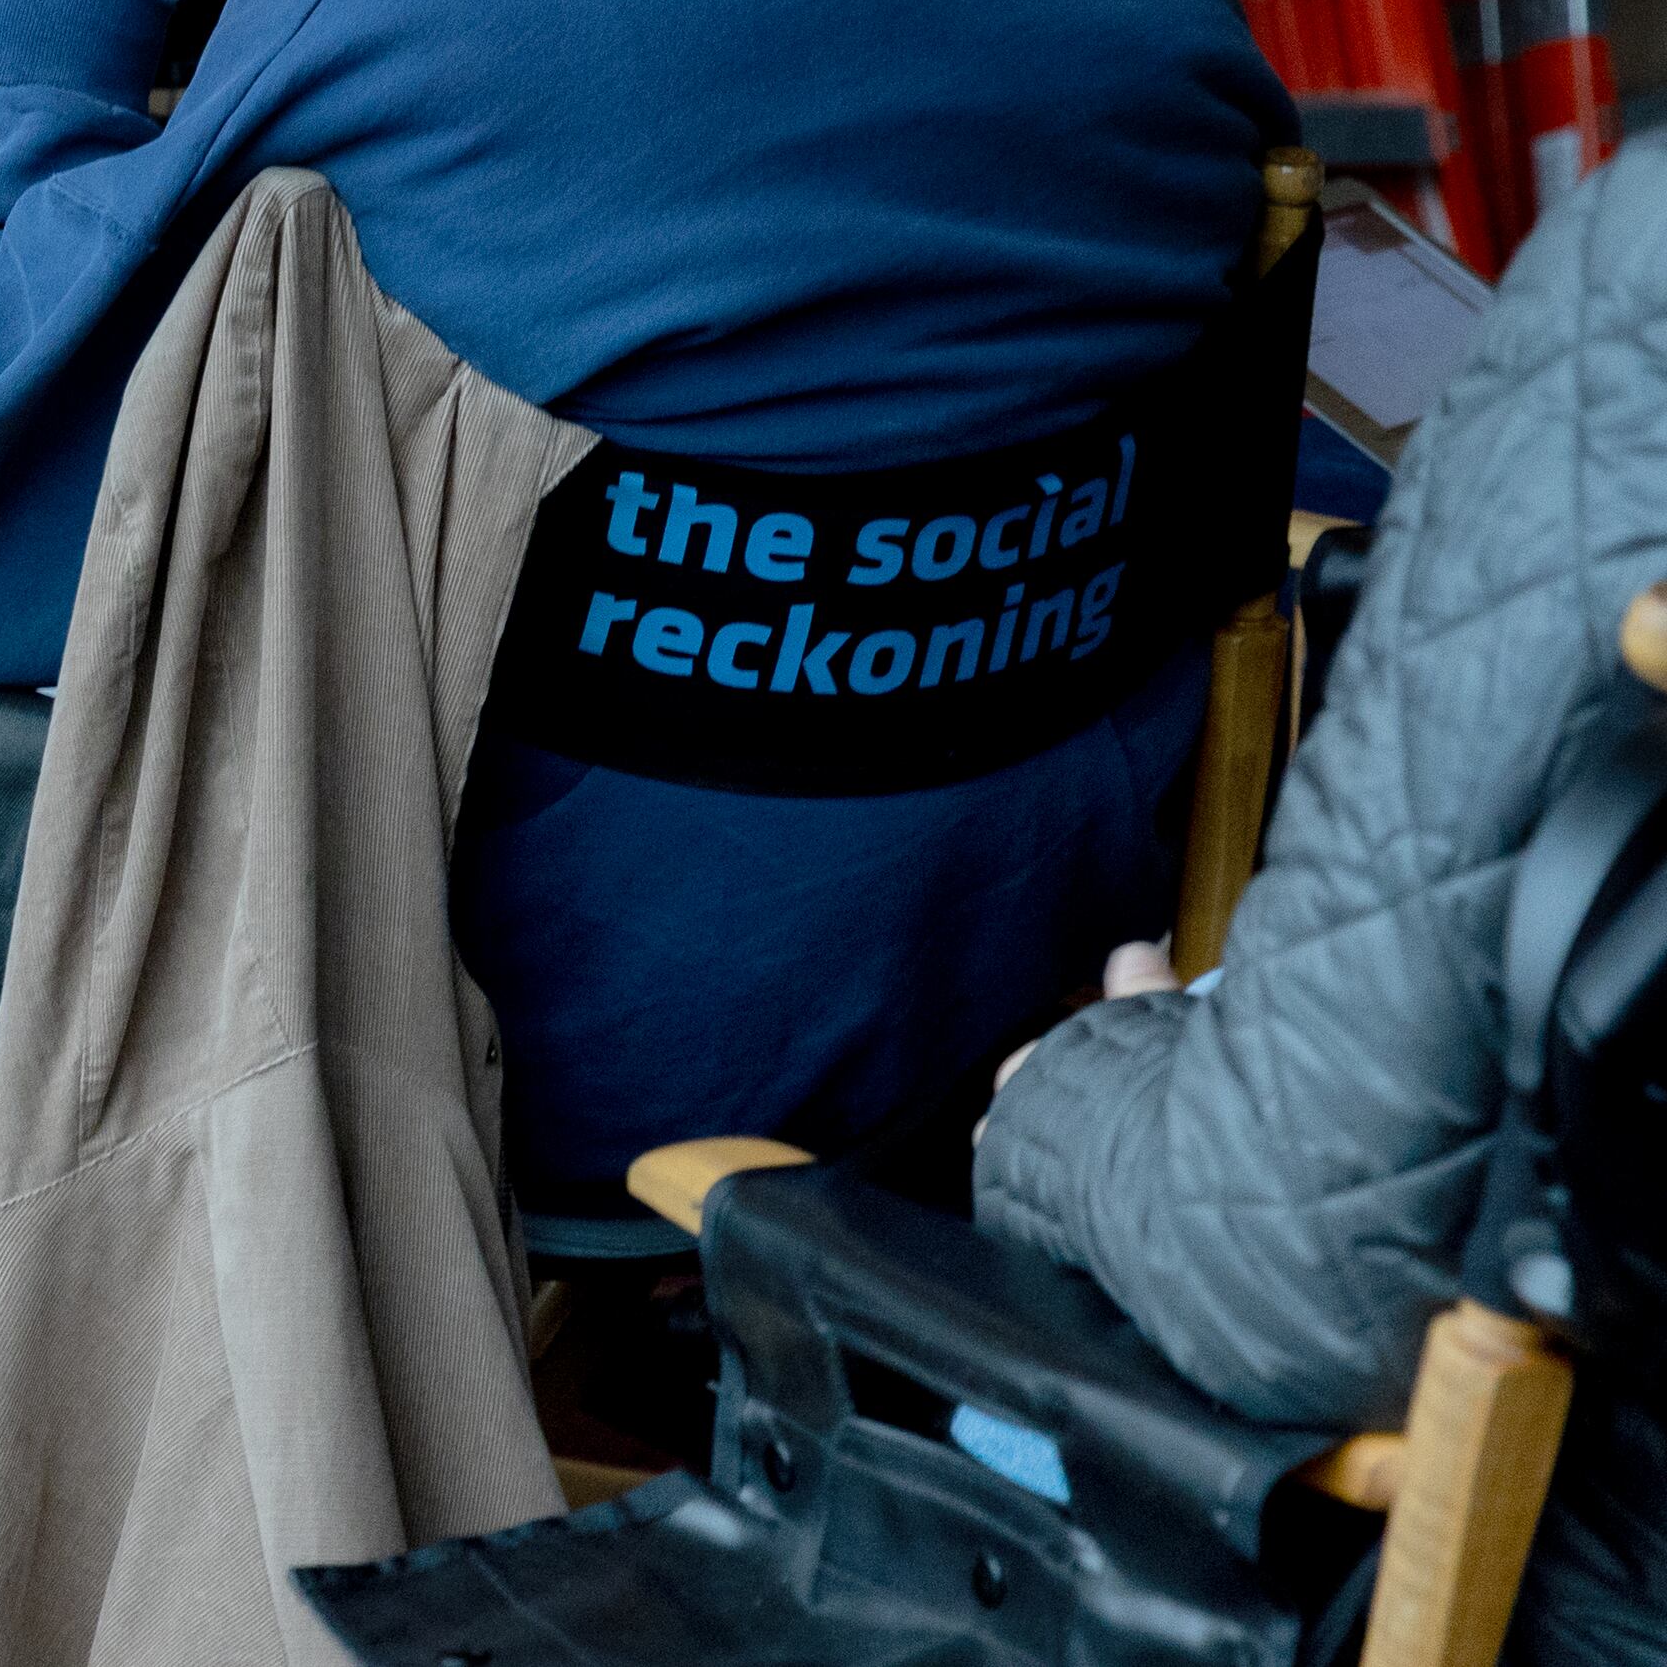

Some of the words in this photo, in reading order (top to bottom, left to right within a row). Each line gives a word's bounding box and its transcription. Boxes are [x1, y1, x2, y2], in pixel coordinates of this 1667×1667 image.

[604, 470, 816, 584] the
[844, 432, 1138, 587] social
[578, 561, 1127, 697] reckoning
